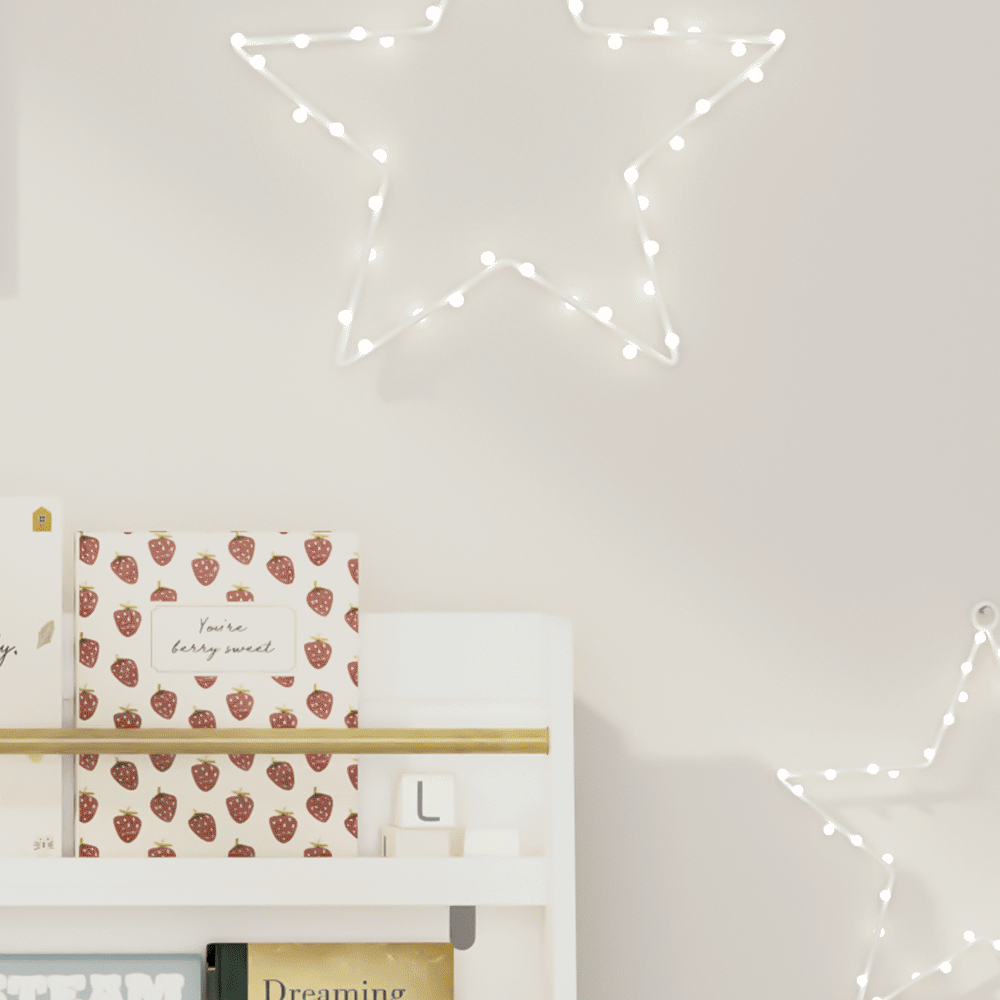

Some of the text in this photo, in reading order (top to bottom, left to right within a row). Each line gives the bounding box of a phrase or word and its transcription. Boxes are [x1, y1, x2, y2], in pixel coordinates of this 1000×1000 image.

[199, 616, 248, 634] You're
[171, 639, 275, 661] berry sweet
[416, 780, 441, 822] L
